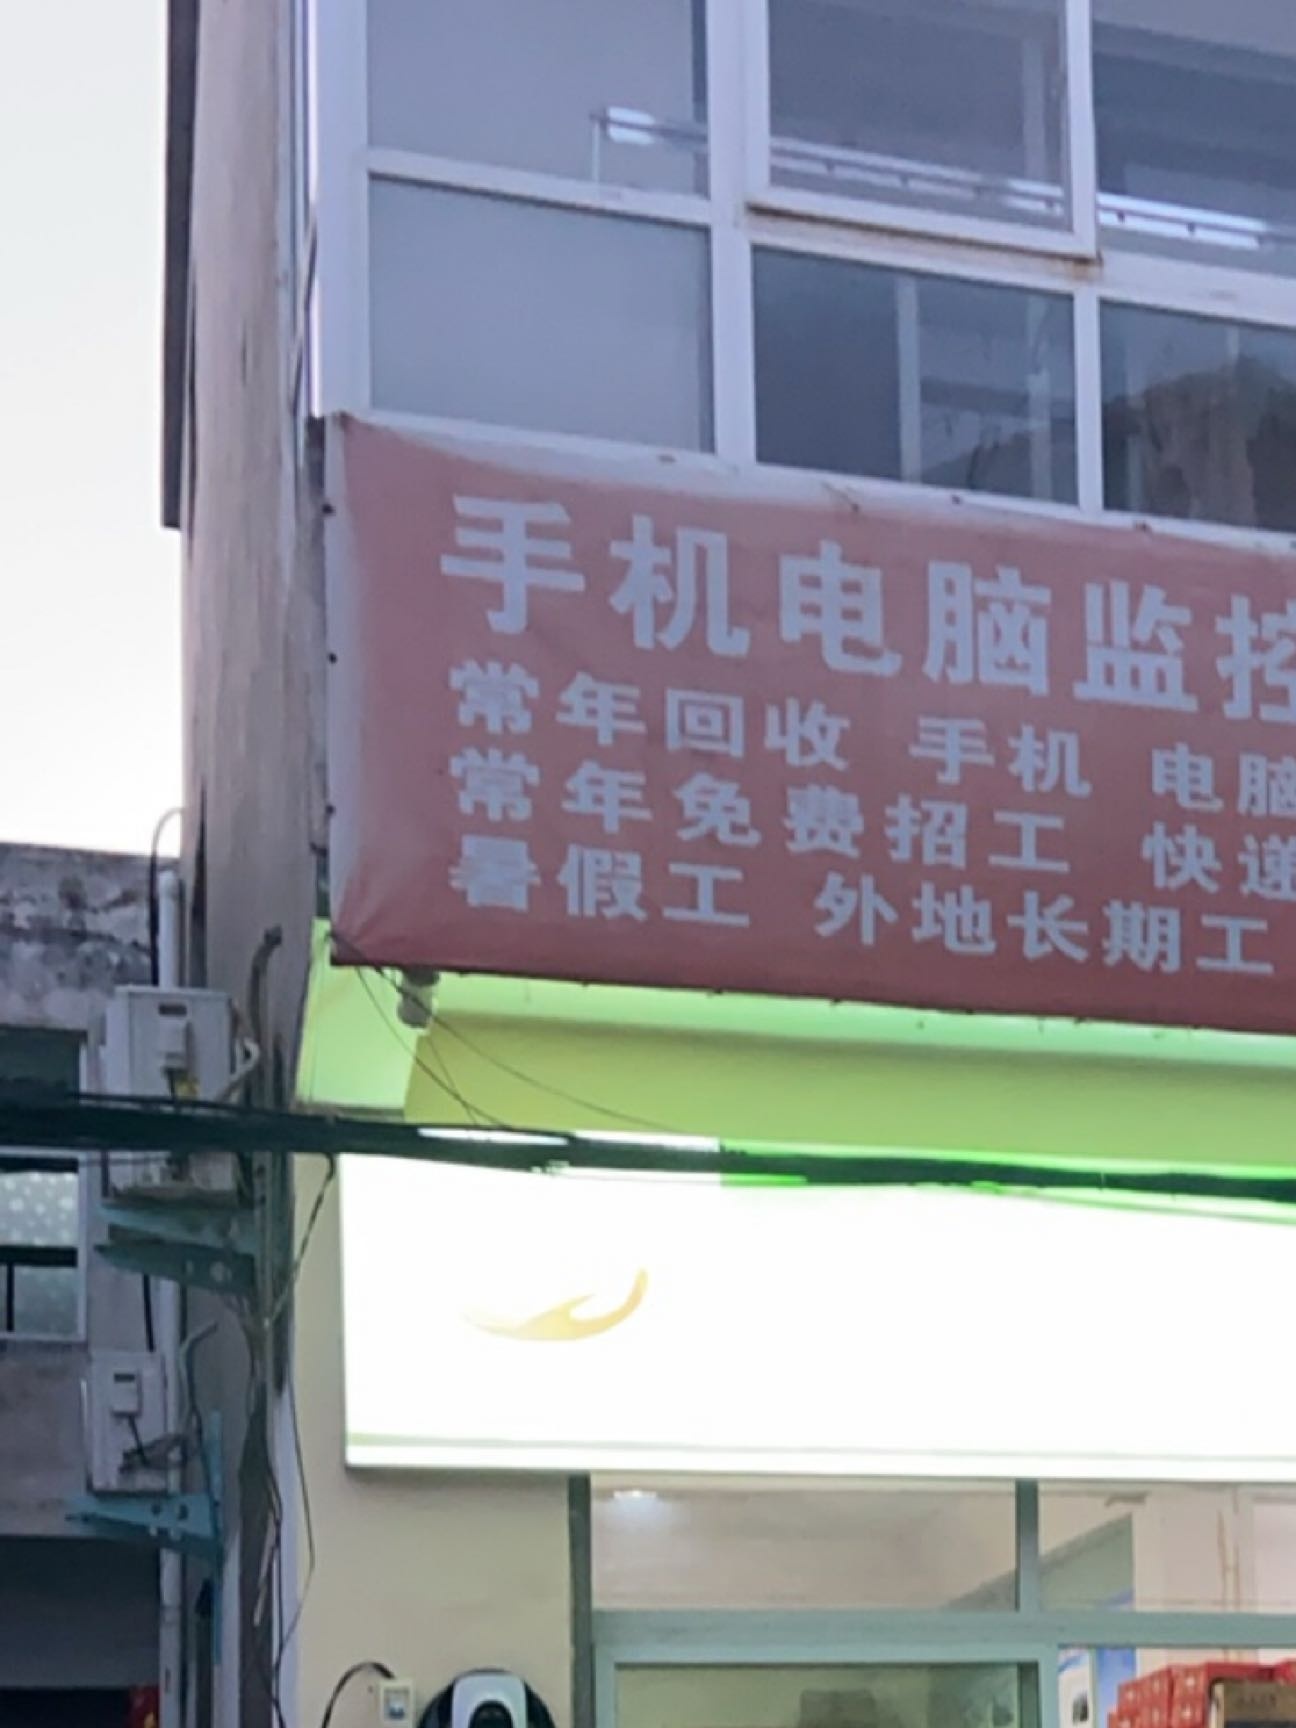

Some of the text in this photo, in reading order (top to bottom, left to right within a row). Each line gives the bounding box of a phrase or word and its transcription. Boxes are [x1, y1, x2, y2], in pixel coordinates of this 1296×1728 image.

[448, 658, 848, 771] 常年回收
[909, 714, 1093, 799] 手机
[448, 746, 1071, 875] 常年免费招工
[451, 832, 1274, 976] 暑假工 外地长期工
